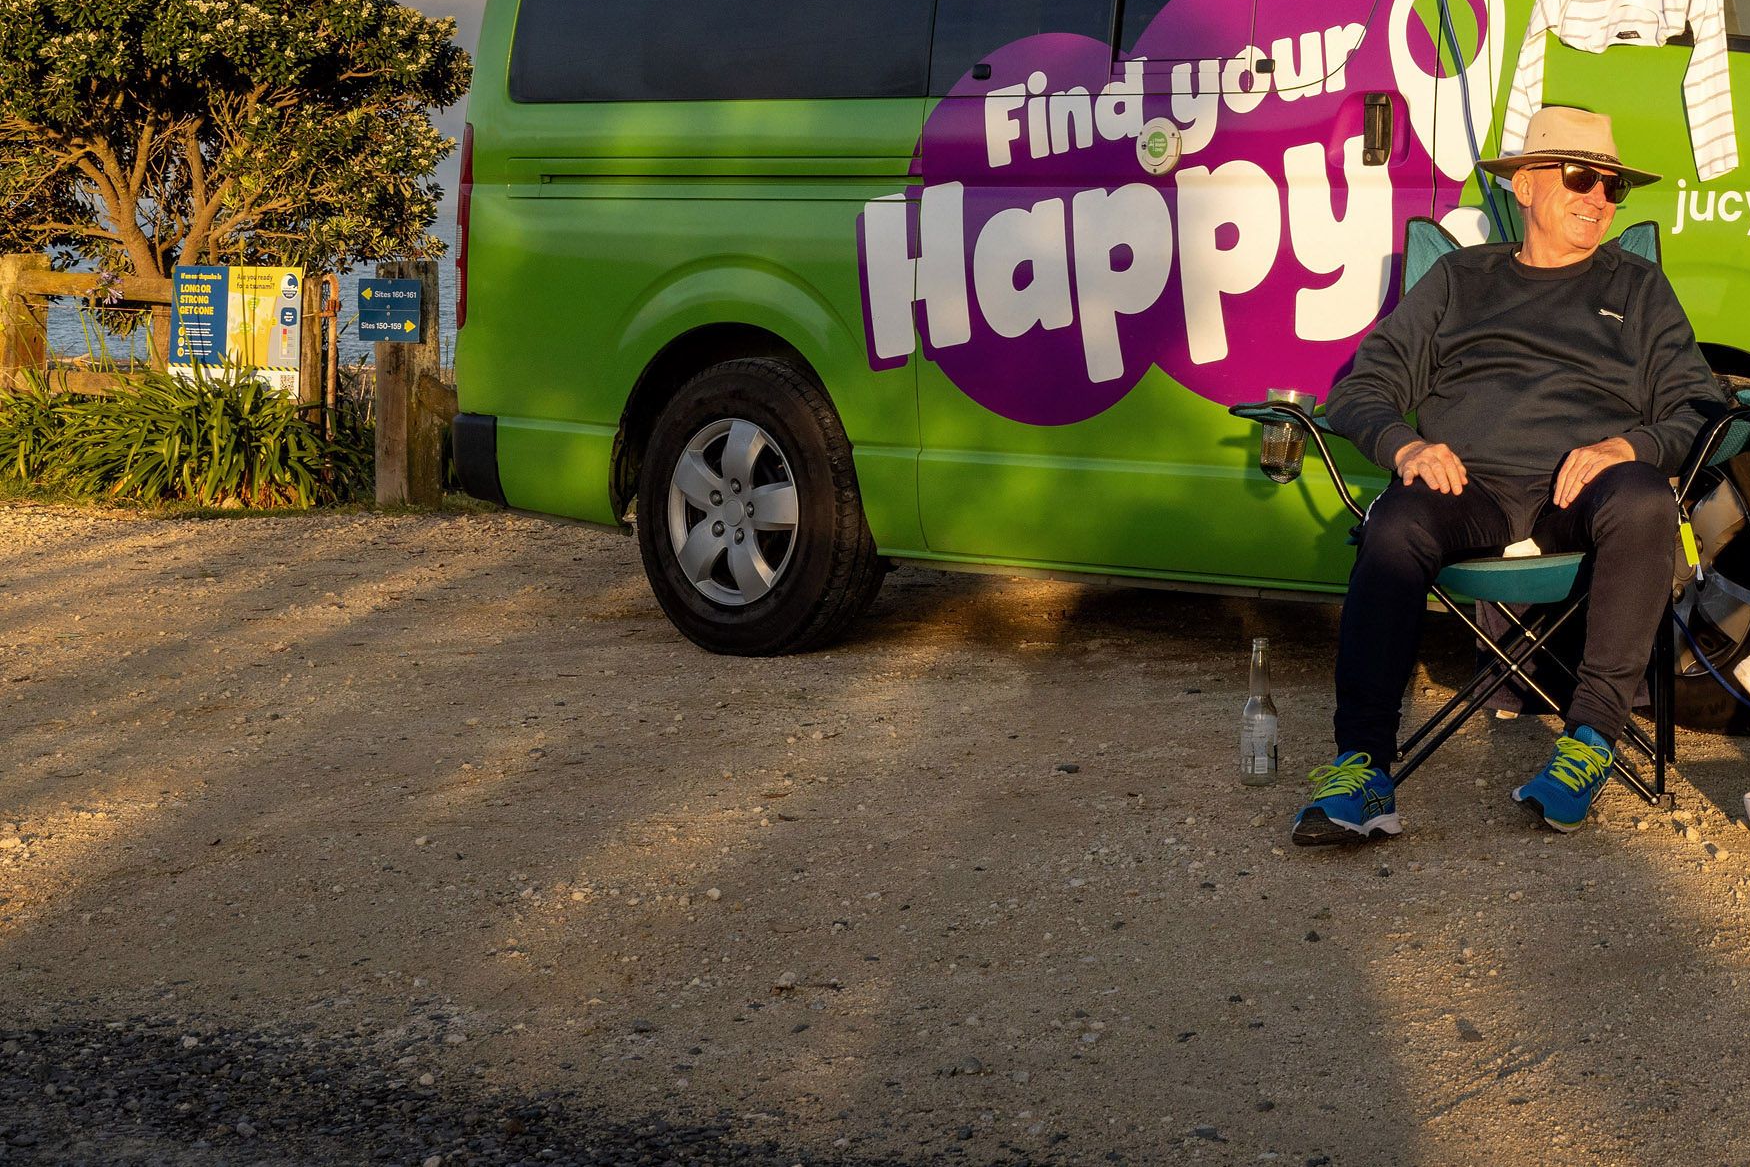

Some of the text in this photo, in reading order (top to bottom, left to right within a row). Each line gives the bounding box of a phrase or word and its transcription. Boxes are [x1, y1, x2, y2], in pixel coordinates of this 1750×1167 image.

[984, 22, 1367, 168] Find your
[180, 284, 212, 294] LONG OR
[374, 290, 417, 299] Sites 160-161
[179, 295, 209, 304] STRONG
[179, 306, 215, 315] GET GONE
[360, 321, 402, 330] Sites 150-159
